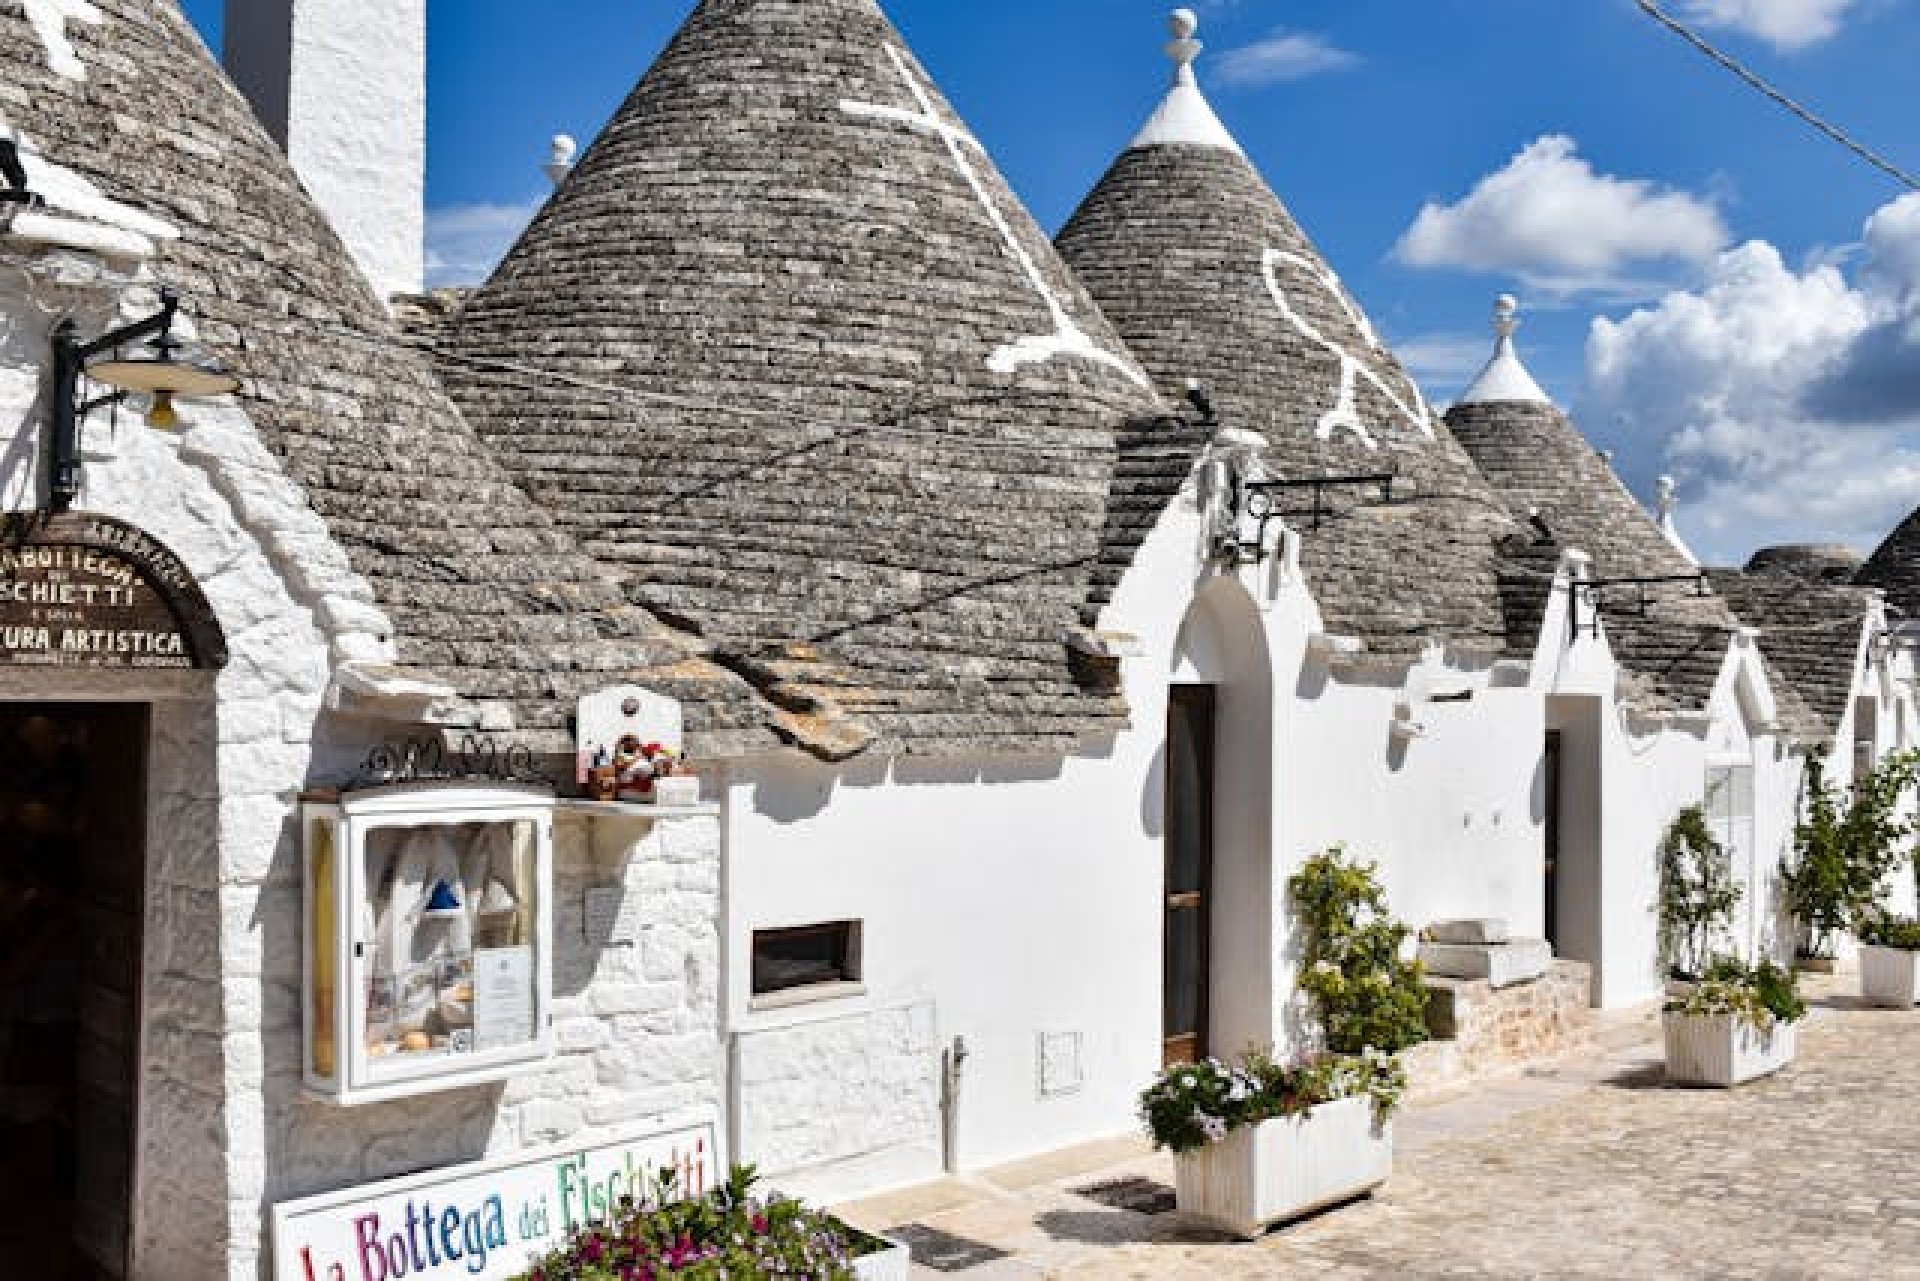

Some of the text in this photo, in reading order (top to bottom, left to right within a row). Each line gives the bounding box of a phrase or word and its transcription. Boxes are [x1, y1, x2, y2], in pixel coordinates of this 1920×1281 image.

[62, 629, 183, 652] ARTISTICA
[352, 1193, 507, 1281] Bottega
[518, 1194, 550, 1240] dei
[555, 1137, 705, 1230] Fischitti
